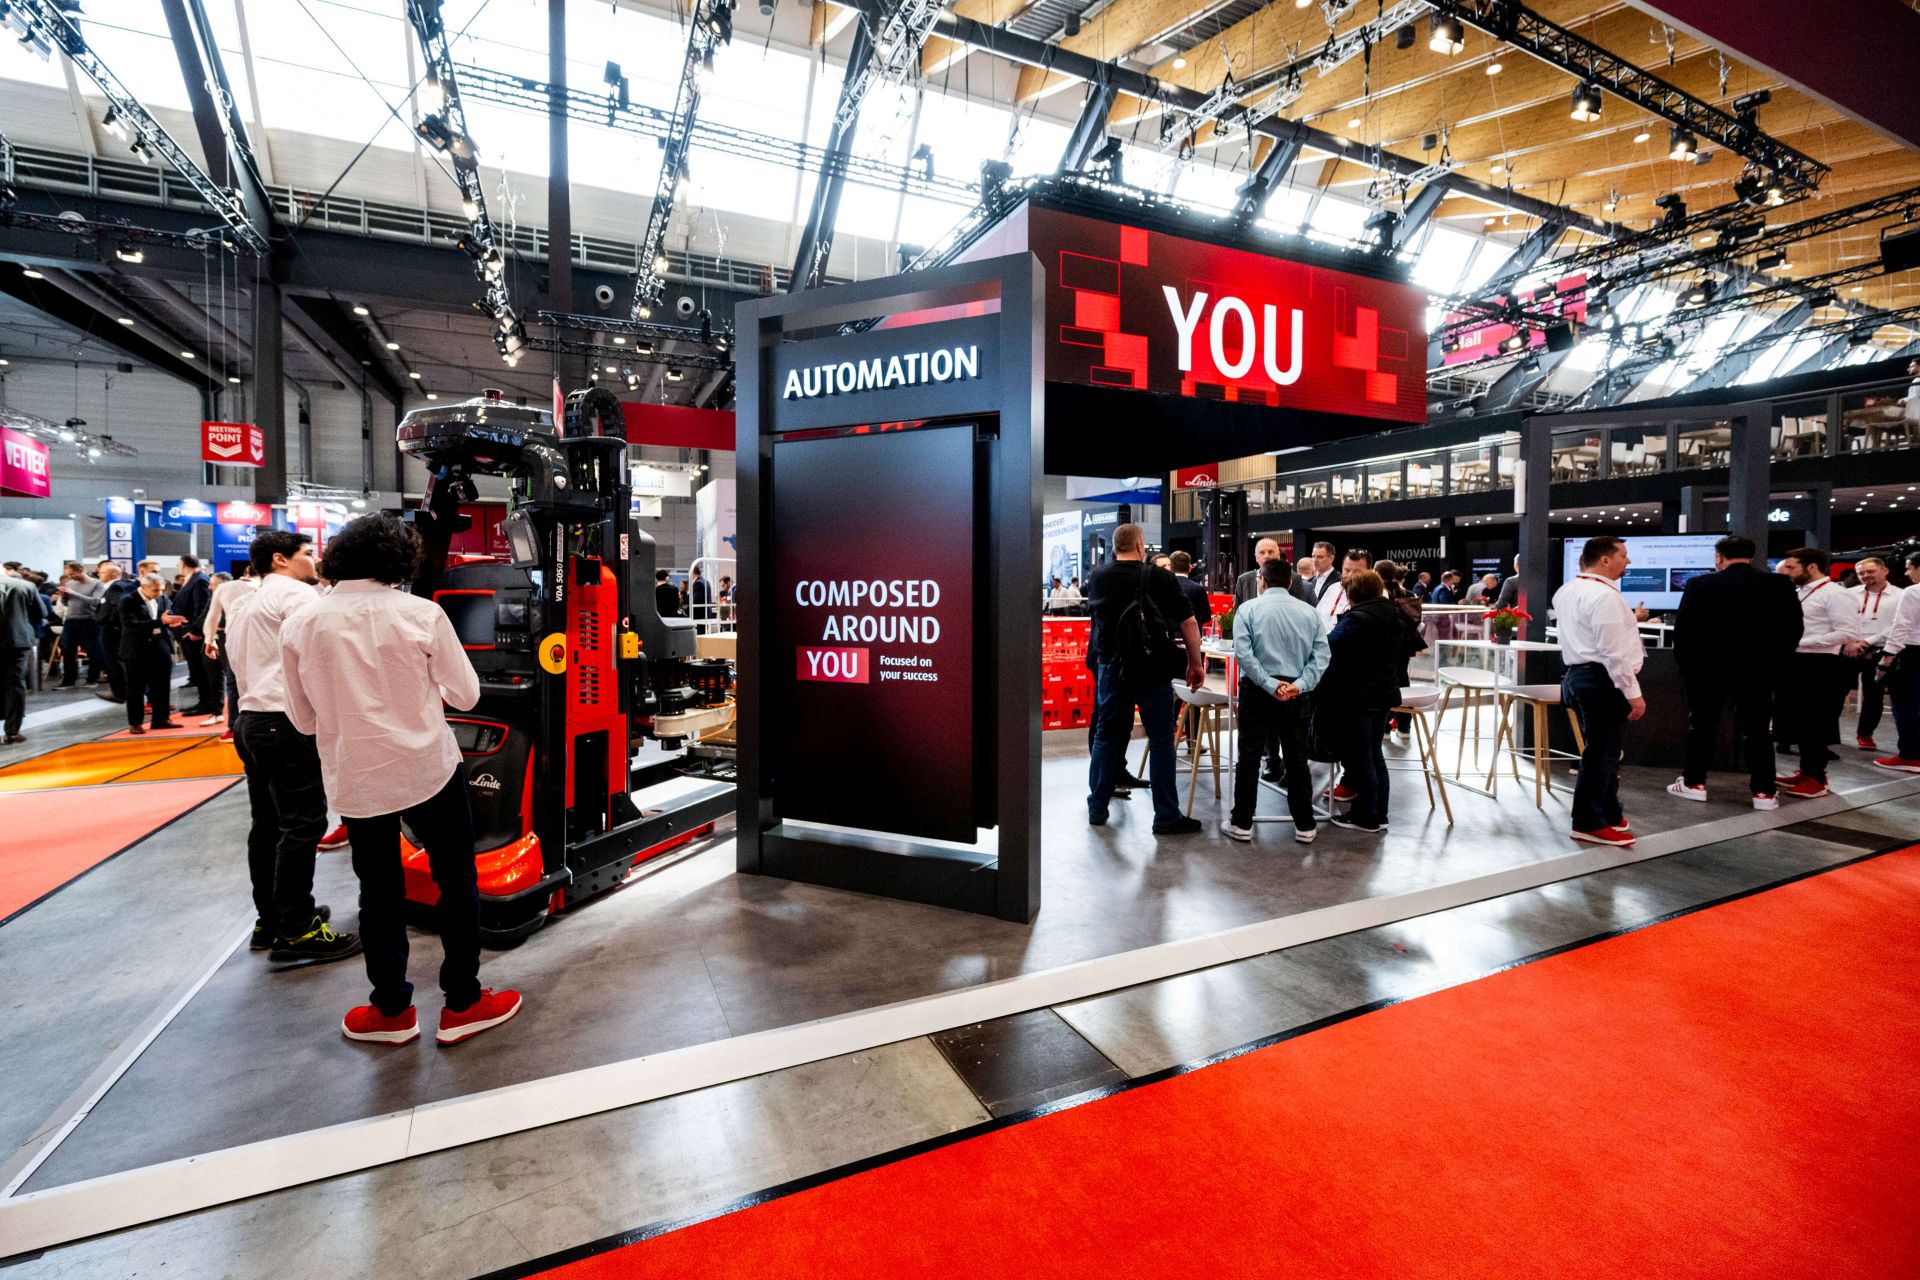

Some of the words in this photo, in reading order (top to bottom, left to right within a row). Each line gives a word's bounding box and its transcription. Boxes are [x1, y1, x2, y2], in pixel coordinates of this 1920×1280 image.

[1162, 285, 1303, 385] YOU
[783, 346, 979, 399] AUTOMATION
[208, 425, 242, 434] MEETING
[208, 433, 242, 443] POINT
[1387, 547, 1441, 559] INNOVATIO
[555, 585, 563, 602] VDA
[795, 580, 941, 608] COMPOSED
[822, 615, 941, 644] AROUND
[806, 651, 858, 679] YOU
[880, 655, 917, 667] Focused
[919, 658, 932, 667] on
[880, 670, 900, 682] your
[903, 672, 938, 682] success
[469, 773, 501, 790] Linde
